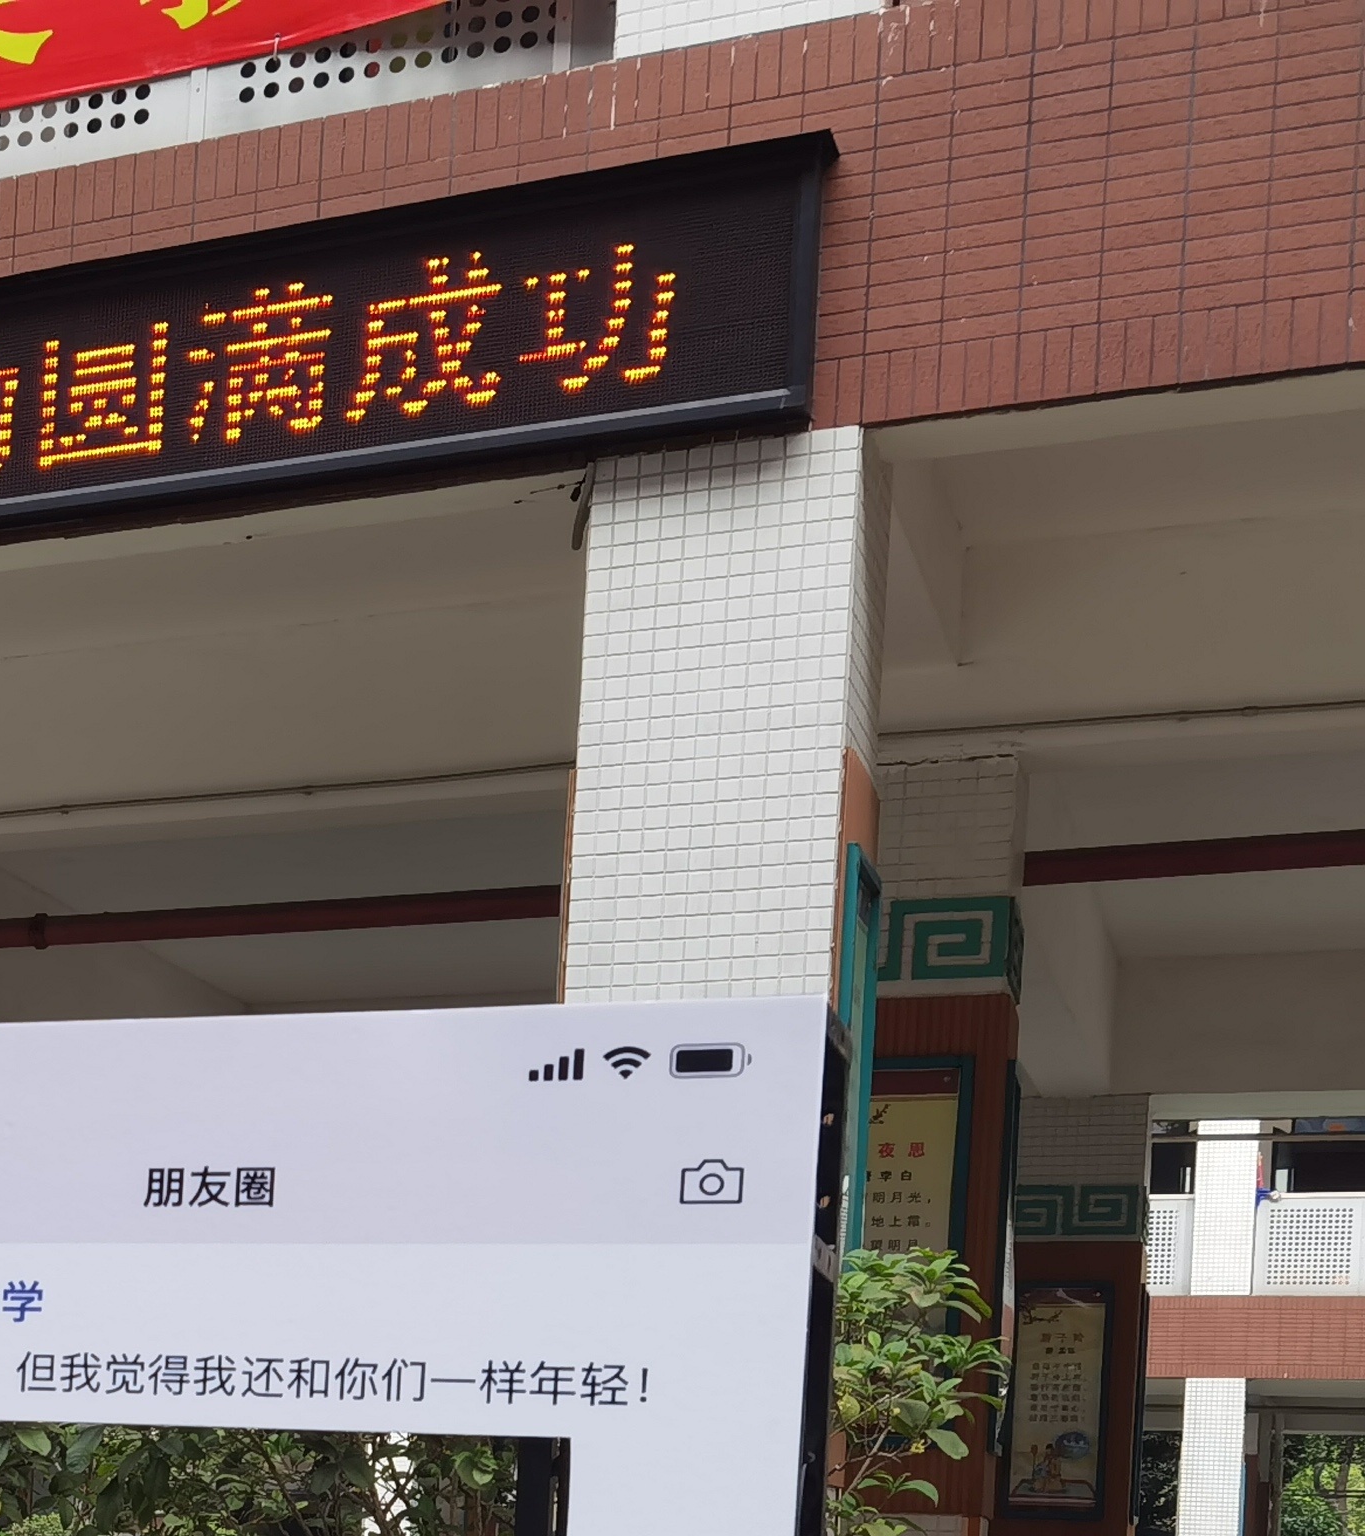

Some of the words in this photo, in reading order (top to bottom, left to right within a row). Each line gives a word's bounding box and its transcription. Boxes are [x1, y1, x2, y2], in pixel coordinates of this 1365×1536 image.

[878, 1142, 926, 1159] 夜思
[143, 1166, 277, 1208] 朋友圈
